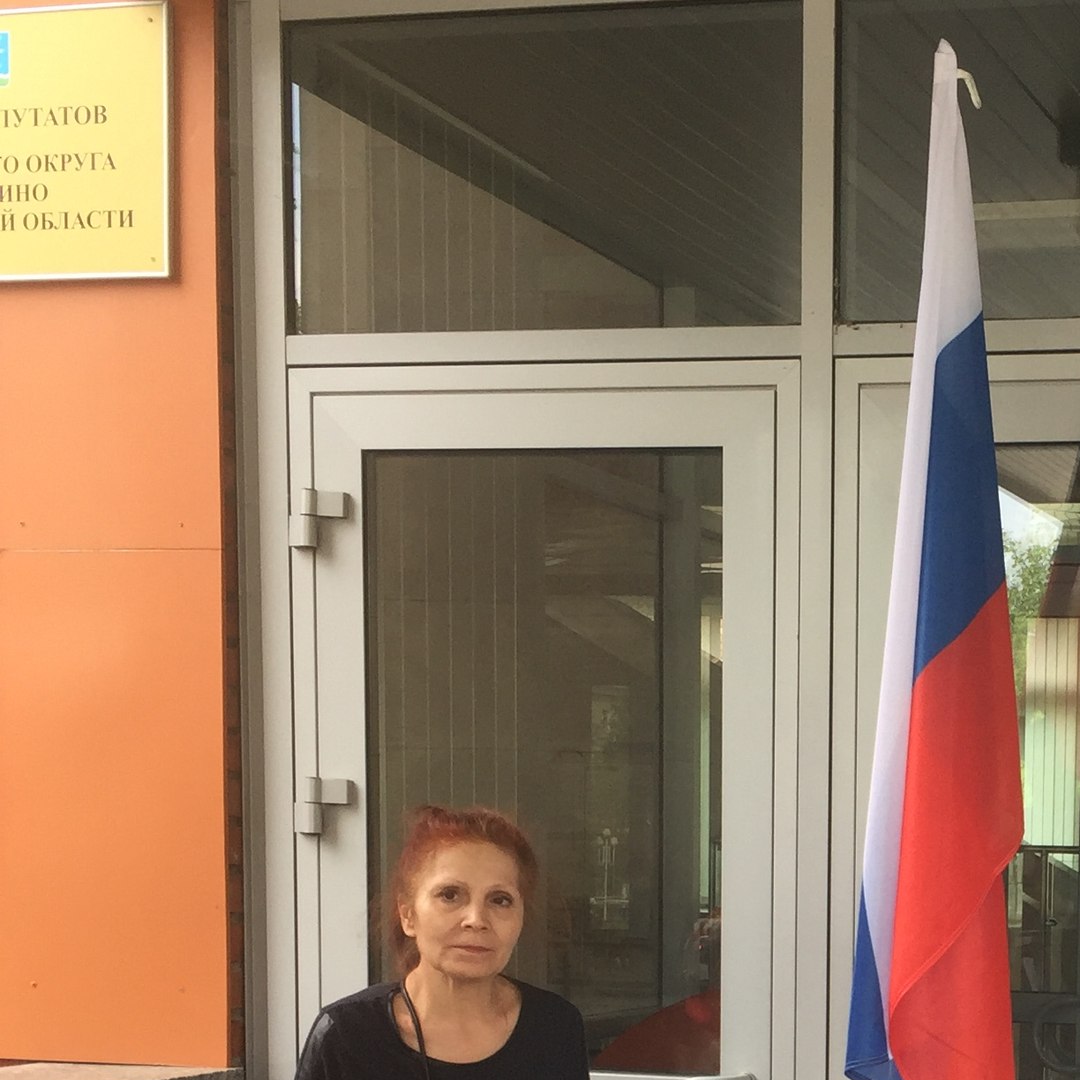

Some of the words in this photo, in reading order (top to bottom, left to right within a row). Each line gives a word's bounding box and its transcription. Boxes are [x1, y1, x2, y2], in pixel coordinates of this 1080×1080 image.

[0, 154, 19, 174] О
[26, 152, 117, 174] ОКРУГА
[0, 183, 49, 203] ИНО
[1, 208, 15, 232] Й
[23, 209, 135, 231] ОБЛАСТИ
